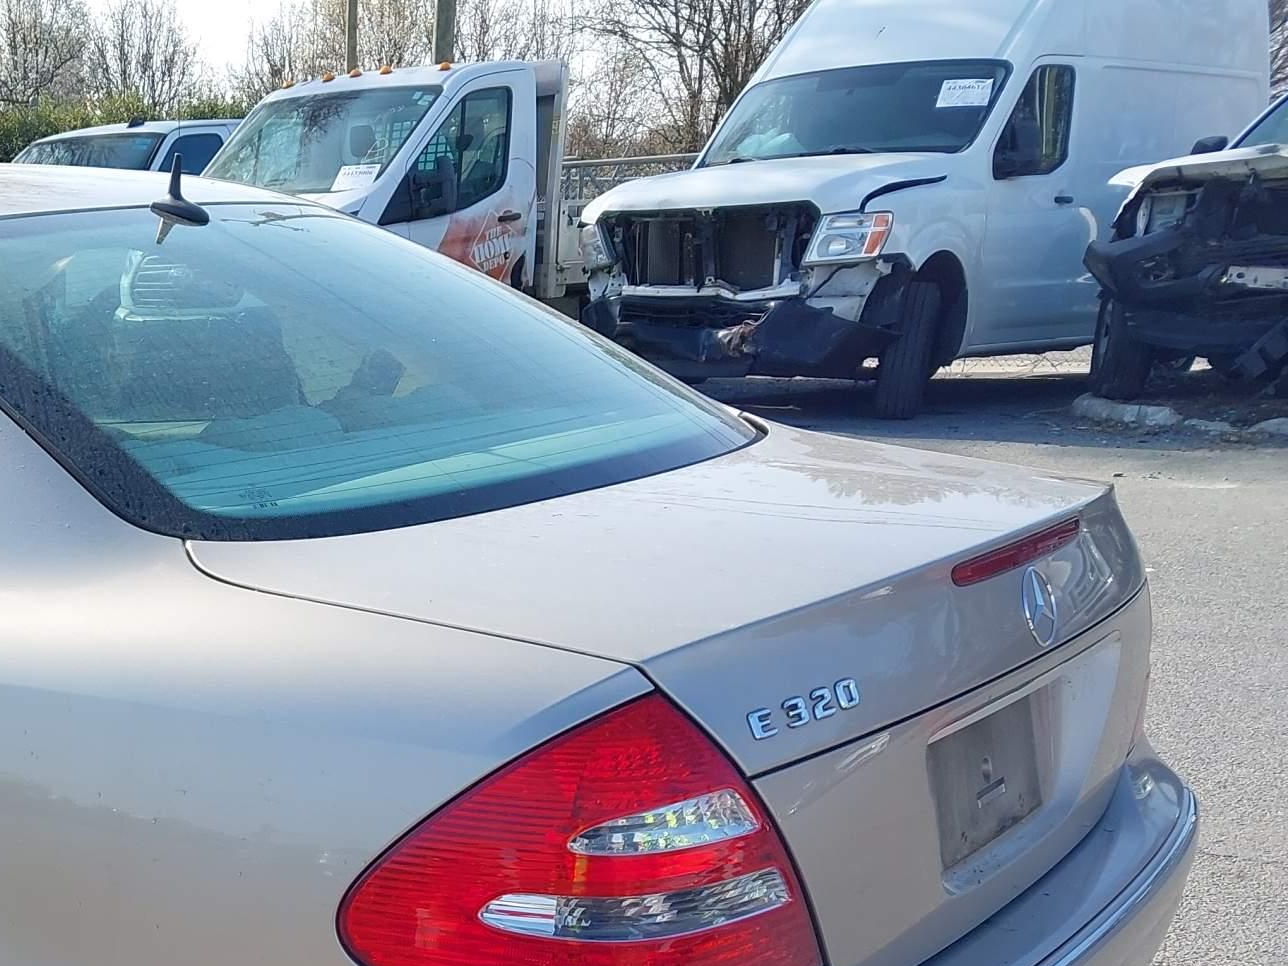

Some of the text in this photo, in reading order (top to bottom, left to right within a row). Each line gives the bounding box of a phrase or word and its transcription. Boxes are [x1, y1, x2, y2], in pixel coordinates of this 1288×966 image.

[486, 225, 503, 240] THE
[483, 255, 510, 272] DEPO
[747, 678, 860, 740] E 320
